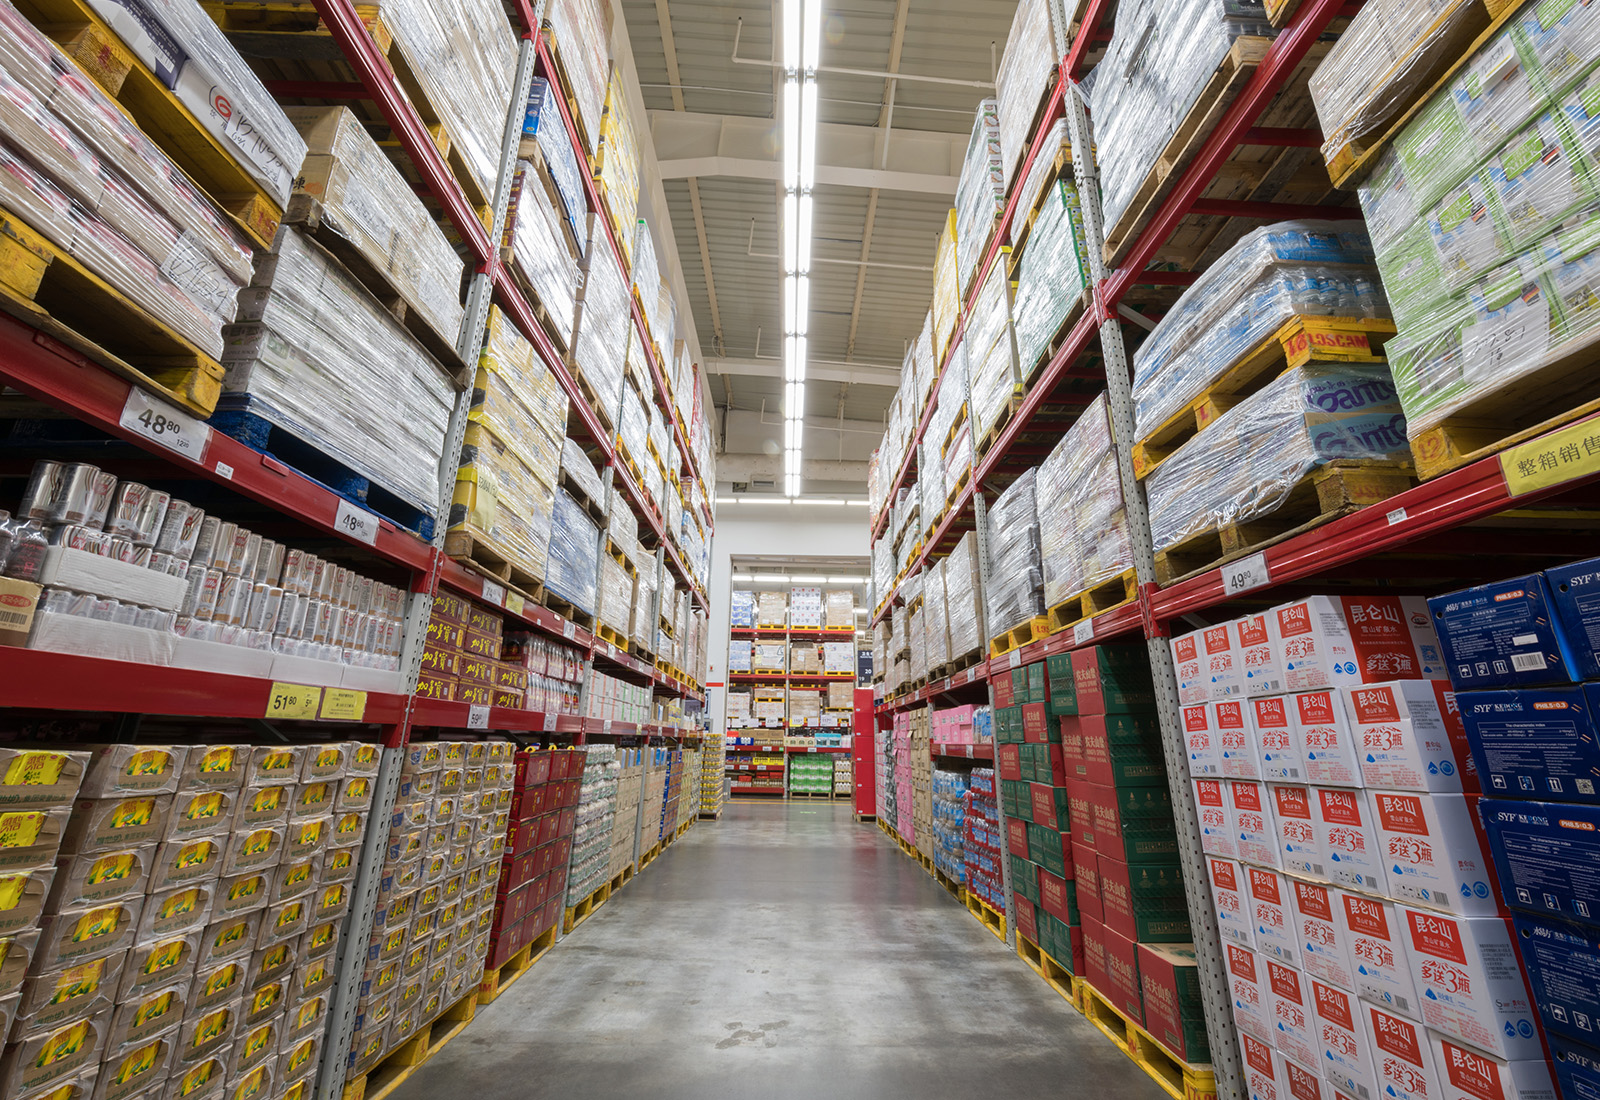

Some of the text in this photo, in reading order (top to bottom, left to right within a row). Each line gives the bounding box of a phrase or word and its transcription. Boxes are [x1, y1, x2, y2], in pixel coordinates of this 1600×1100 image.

[1310, 334, 1370, 348] LOSCAM
[1517, 436, 1600, 478] 整箱销售
[1570, 574, 1591, 587] SYF
[1283, 607, 1304, 623] 昆仑山
[1351, 605, 1399, 624] 昆仑山
[1285, 641, 1315, 658] 多送3瓶
[1367, 656, 1411, 674] 多送3瓶
[1260, 701, 1280, 714] 昆仑山
[1302, 695, 1327, 710] 昆仑山
[1358, 690, 1389, 708] 昆仑山
[1474, 704, 1491, 713] SYF
[1220, 704, 1238, 716] 昆仑山
[1306, 732, 1337, 749] 多送3瓶
[1363, 731, 1403, 751] 多送3瓶
[1236, 784, 1255, 798] 昆仑山
[1280, 789, 1303, 804] 昆仑山
[1325, 792, 1352, 809] 昆仑山
[1383, 797, 1416, 816] 昆仑山
[1498, 812, 1516, 822] SYF
[1283, 825, 1313, 842] 多送3瓶
[1329, 833, 1365, 852] 多送3瓶
[1389, 843, 1433, 864] 多送3瓶
[1254, 872, 1274, 889] 昆仑山
[1300, 884, 1324, 904] 昆仑山
[1350, 899, 1380, 921] 昆仑山
[1304, 925, 1335, 945] 多送3瓶
[1415, 915, 1453, 941] 昆仑山
[1355, 944, 1394, 967] 多送3瓶
[1272, 965, 1295, 988] 昆仑山
[1421, 965, 1471, 993] 多送3瓶
[1144, 975, 1172, 1001] 农夫山泉
[1319, 986, 1345, 1011] 昆仑山
[1377, 1014, 1411, 1044] 昆仑山
[1323, 1029, 1357, 1056] 多送3瓶
[1452, 1047, 1491, 1084] 昆仑山
[1568, 1052, 1589, 1066] SYF
[1291, 1066, 1316, 1094] 昆仑山
[1383, 1063, 1427, 1096] 多送3瓶
